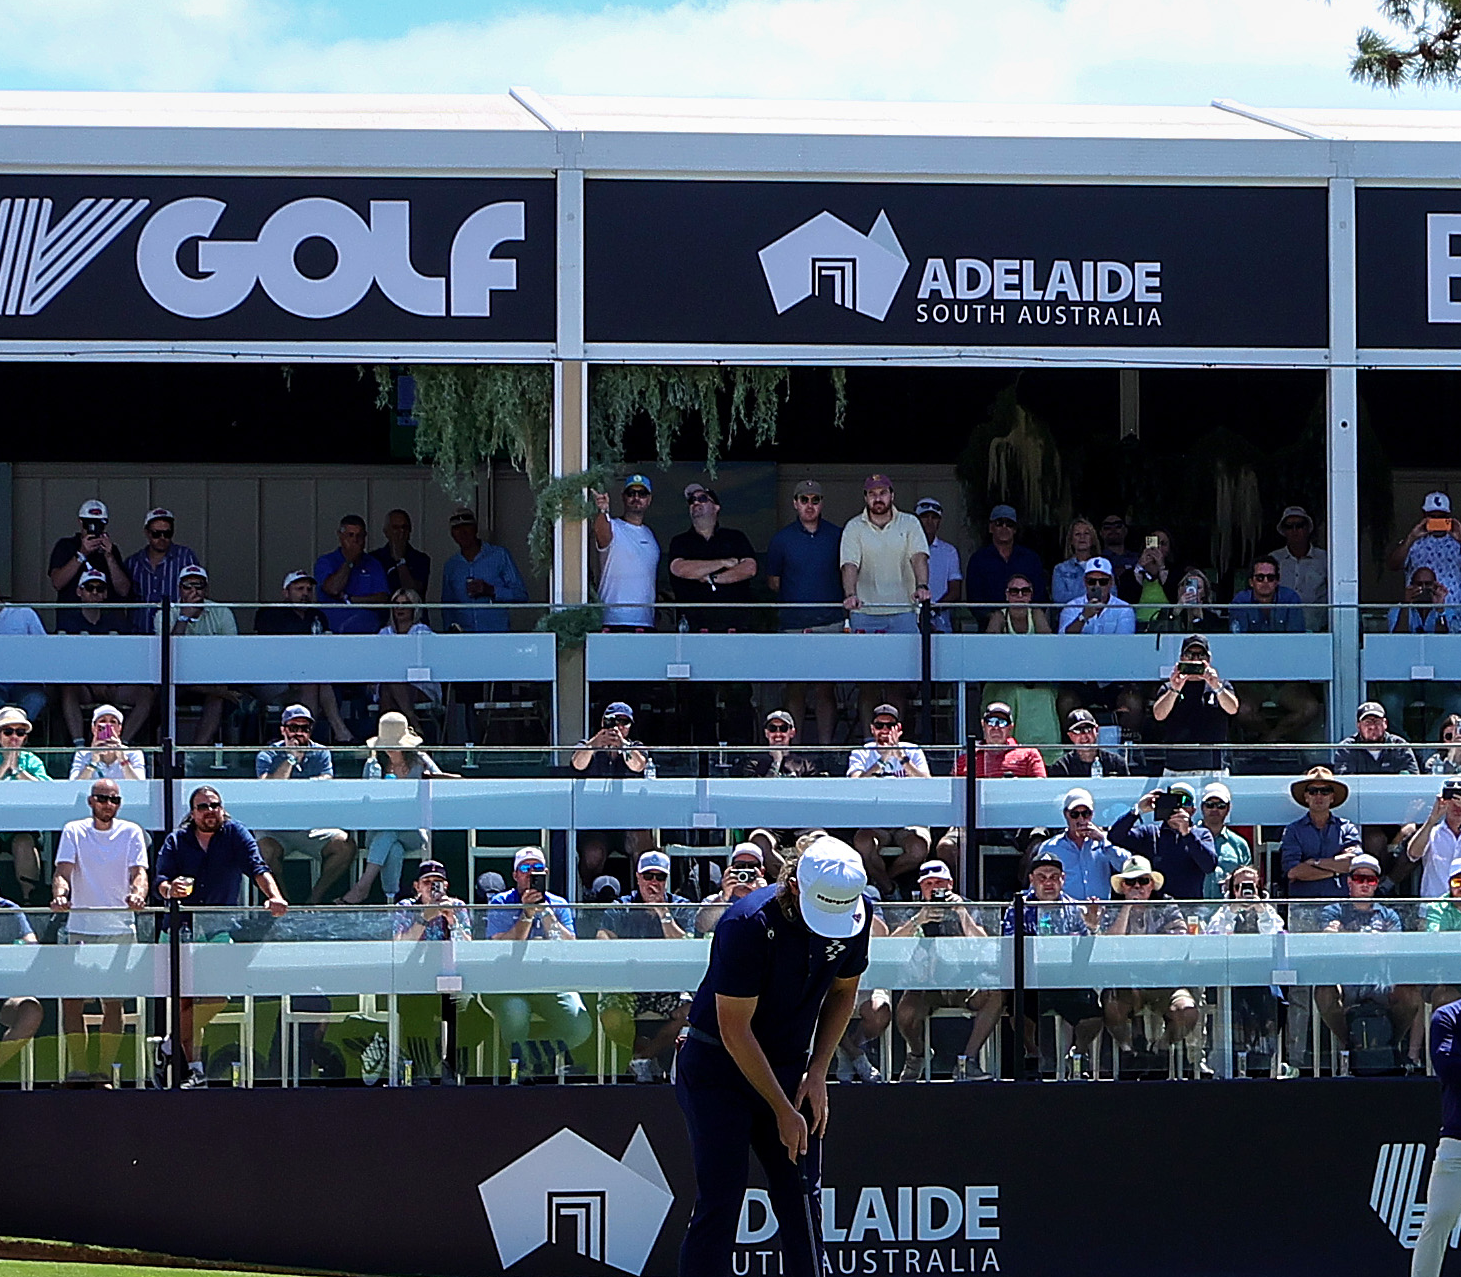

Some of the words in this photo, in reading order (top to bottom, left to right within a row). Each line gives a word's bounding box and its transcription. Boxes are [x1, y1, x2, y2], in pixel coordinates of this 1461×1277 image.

[137, 197, 525, 318] GOLF
[917, 258, 1162, 303] ADELAIDE
[917, 303, 1005, 324] SOUTH
[1018, 305, 1162, 326] AUSTRALIA
[735, 1185, 1001, 1244] DLAIDE
